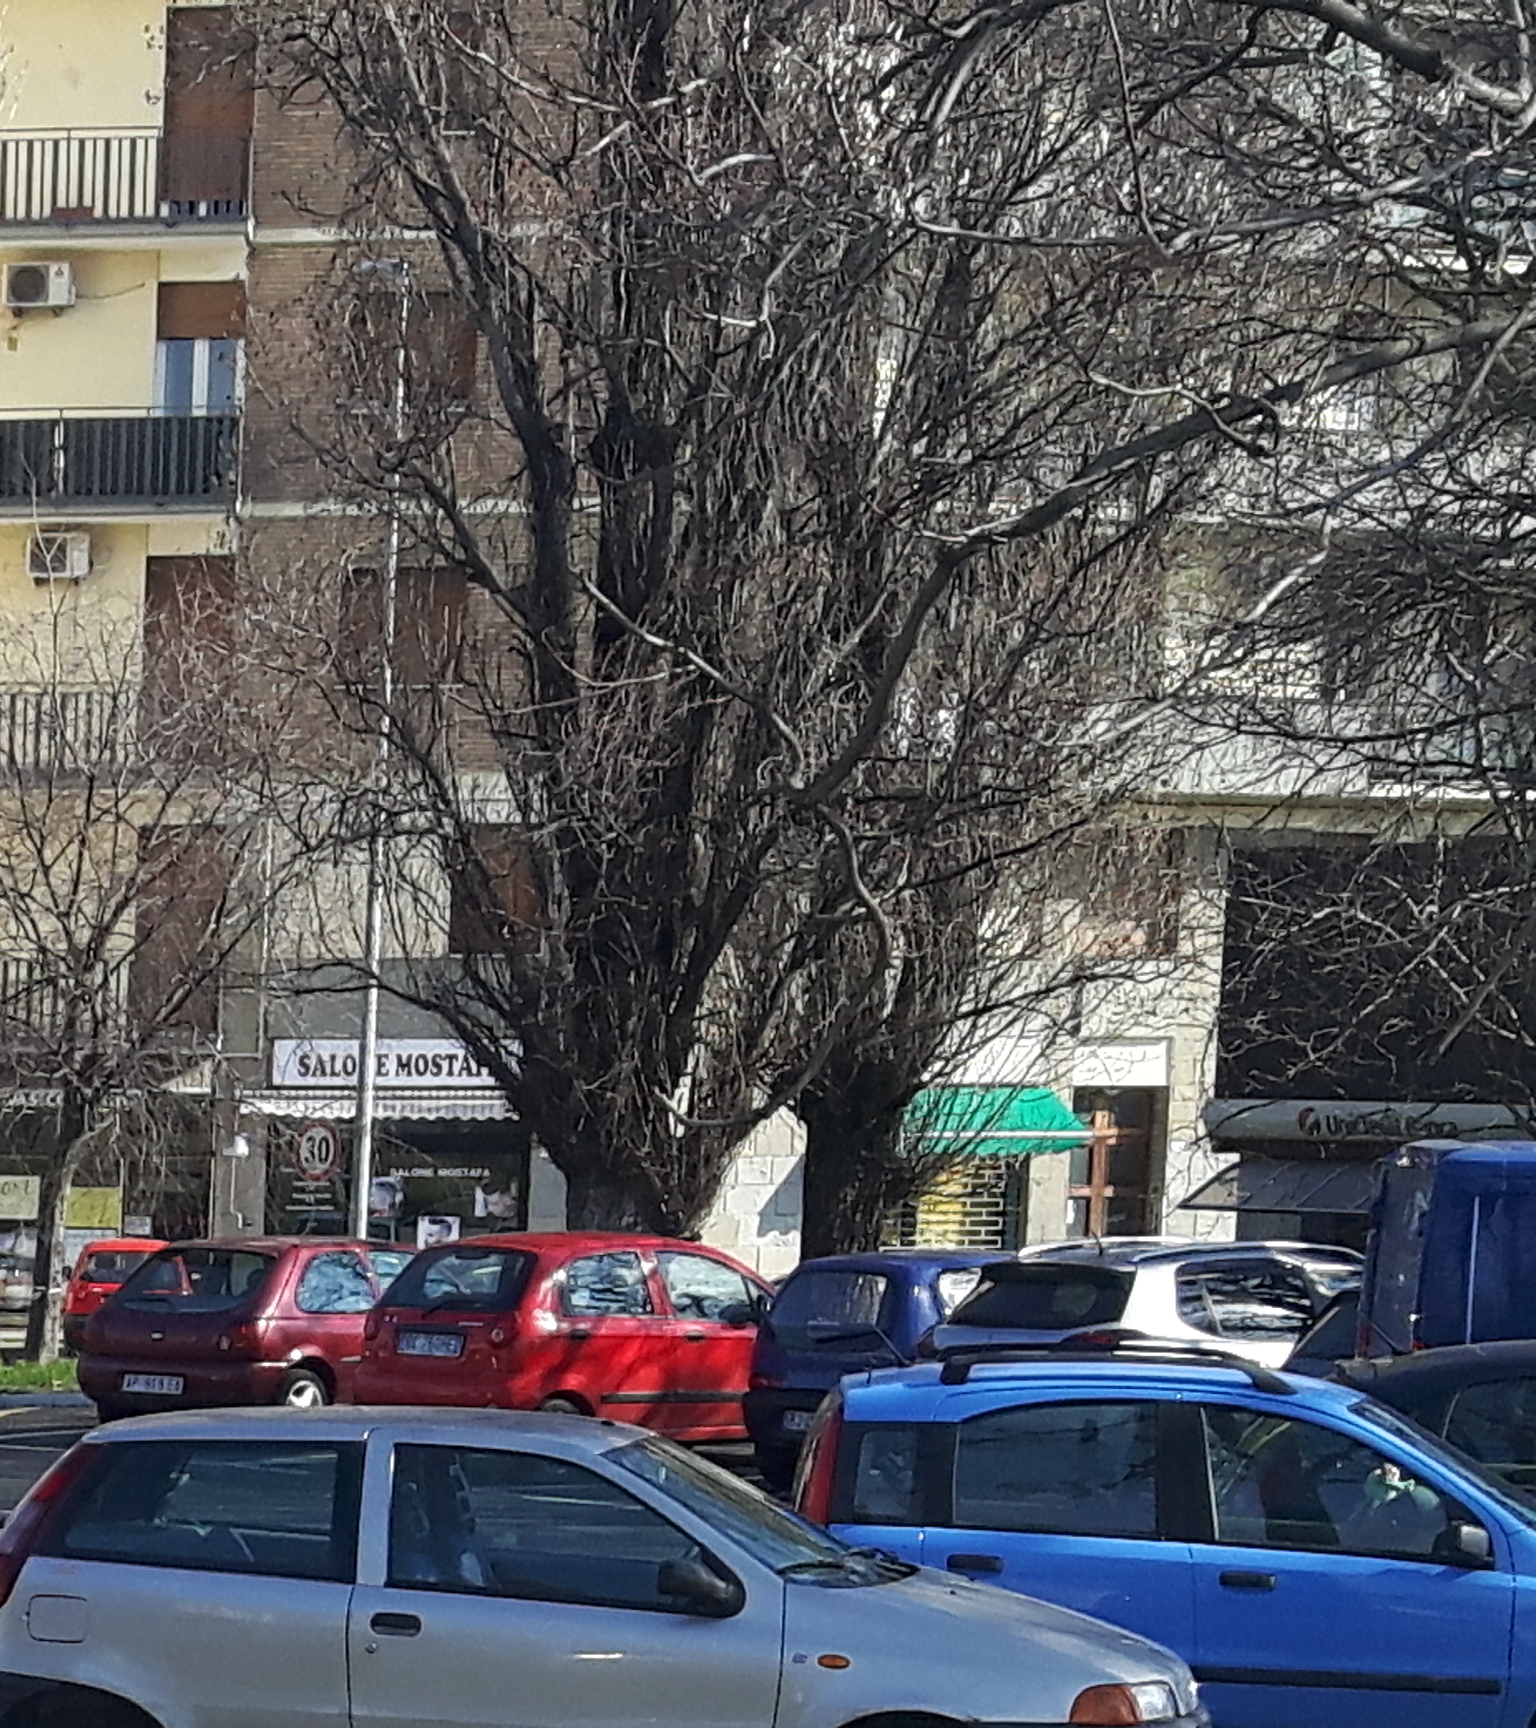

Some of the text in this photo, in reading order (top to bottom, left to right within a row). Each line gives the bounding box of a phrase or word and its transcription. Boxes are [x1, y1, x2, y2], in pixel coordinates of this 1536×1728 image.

[297, 1053, 493, 1078] SALOE MOSTA
[304, 1134, 330, 1165] 30
